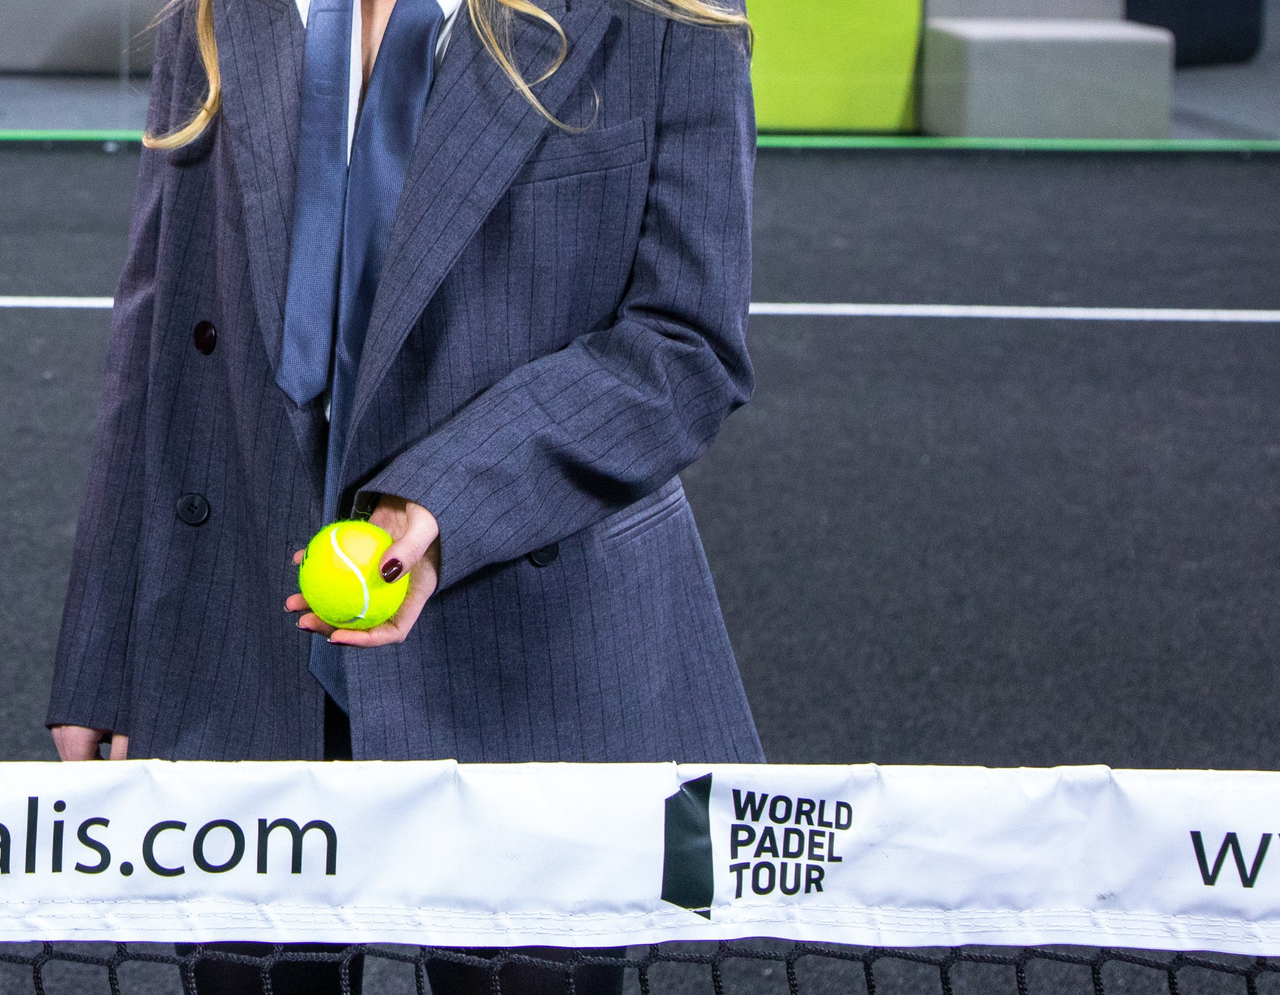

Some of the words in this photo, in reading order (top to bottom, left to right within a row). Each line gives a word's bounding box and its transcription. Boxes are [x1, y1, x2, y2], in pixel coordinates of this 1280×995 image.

[732, 788, 853, 830] WORLD
[730, 823, 843, 863] PADEL
[729, 861, 825, 899] TOUR
